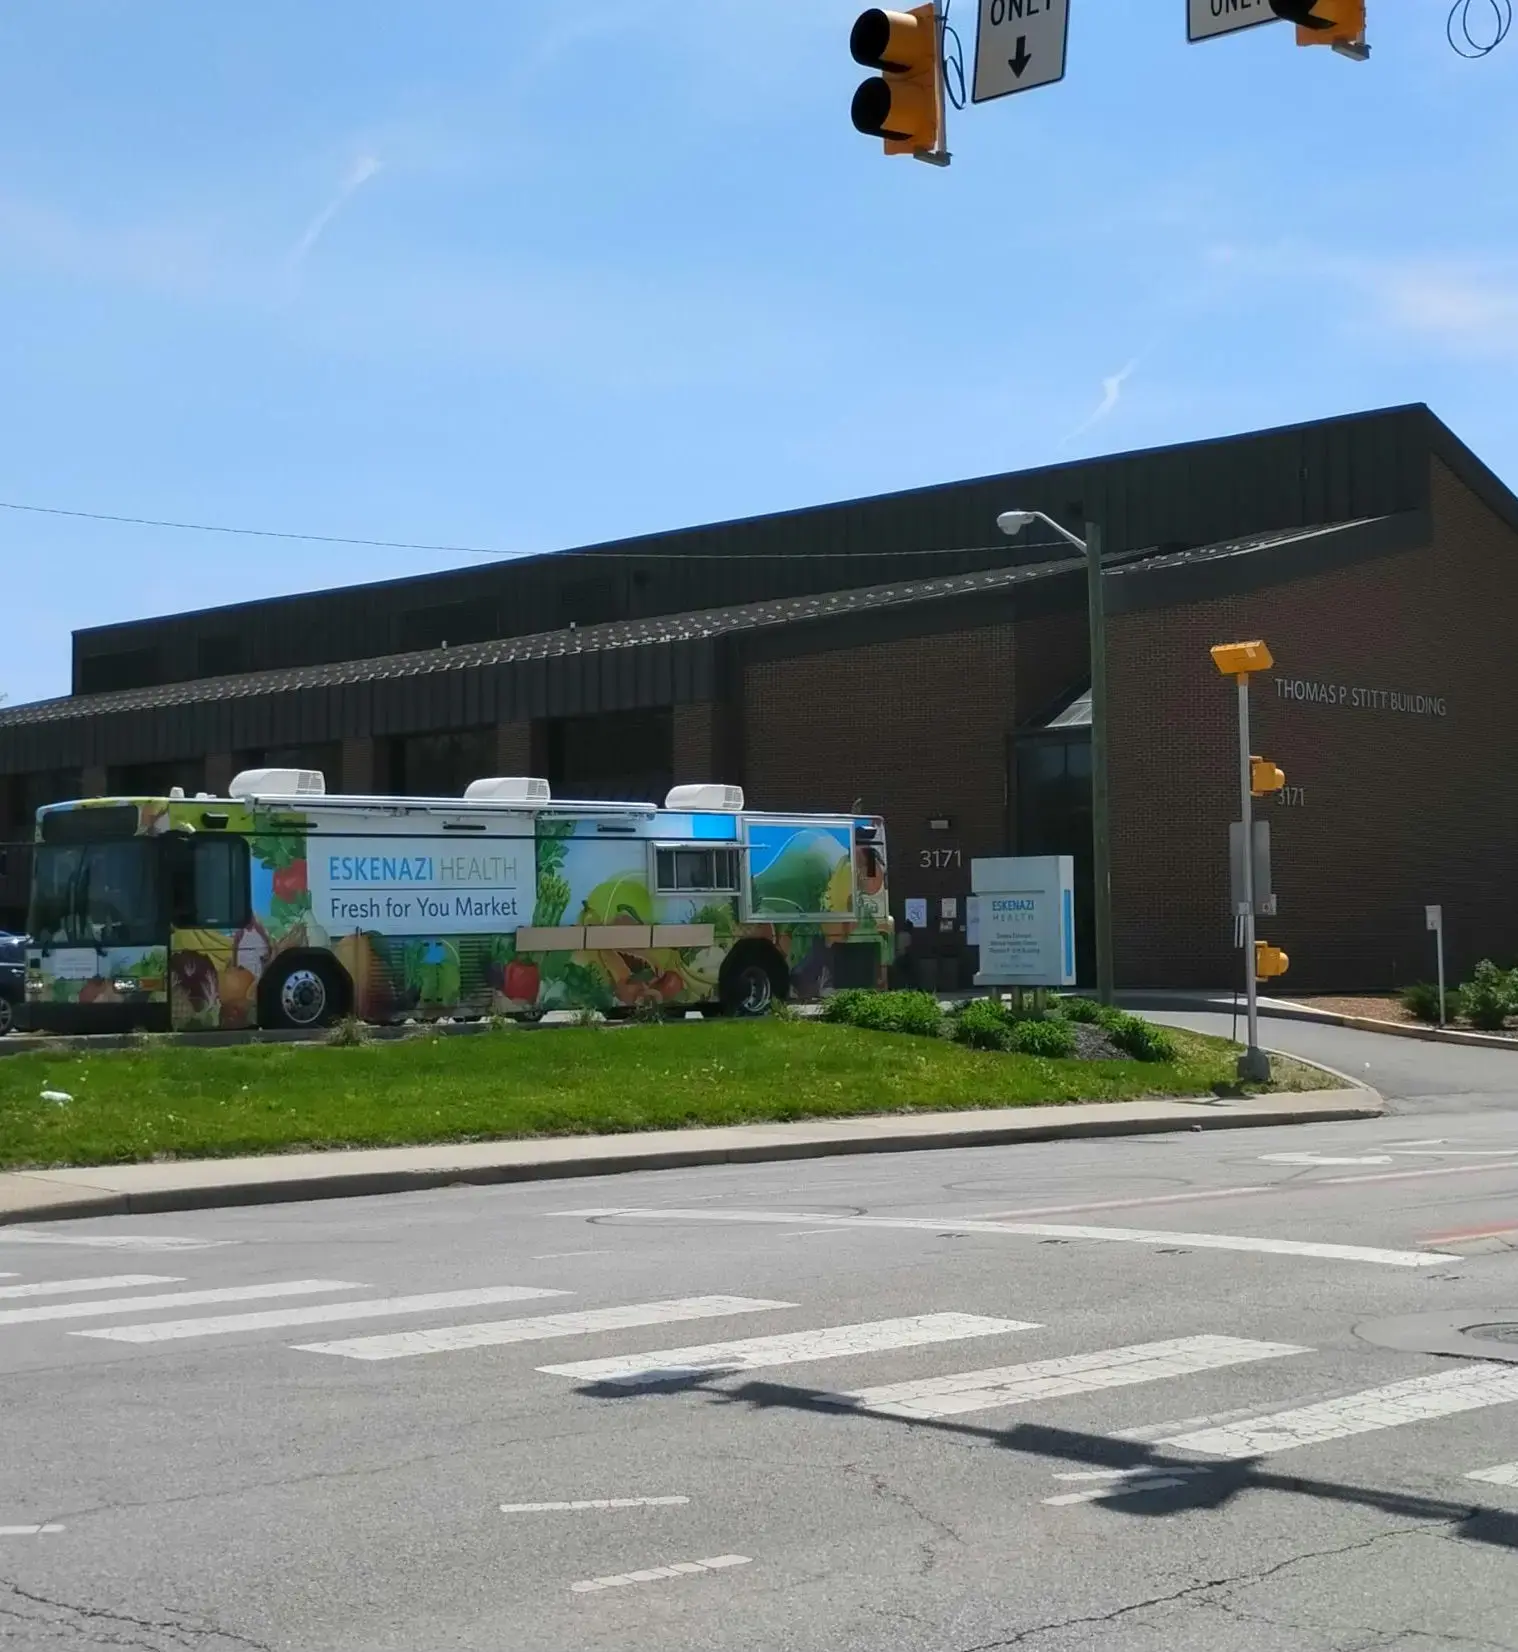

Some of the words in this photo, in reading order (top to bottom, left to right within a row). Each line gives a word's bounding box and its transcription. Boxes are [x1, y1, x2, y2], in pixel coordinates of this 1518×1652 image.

[1274, 677, 1336, 704] THOMAS
[1340, 686, 1348, 705] P
[1351, 688, 1389, 710] STITT
[1391, 692, 1447, 718] BUILDING
[1278, 787, 1304, 807] 3171
[919, 849, 961, 868] 3171
[330, 856, 433, 881] ESKENAZI
[440, 857, 517, 882] HEALTH
[331, 898, 380, 918] Fresh
[386, 897, 411, 918] for
[416, 897, 449, 917] You
[456, 896, 518, 917] Market
[992, 899, 1034, 911] ESKENAZI
[993, 911, 1034, 922] HEALTH
